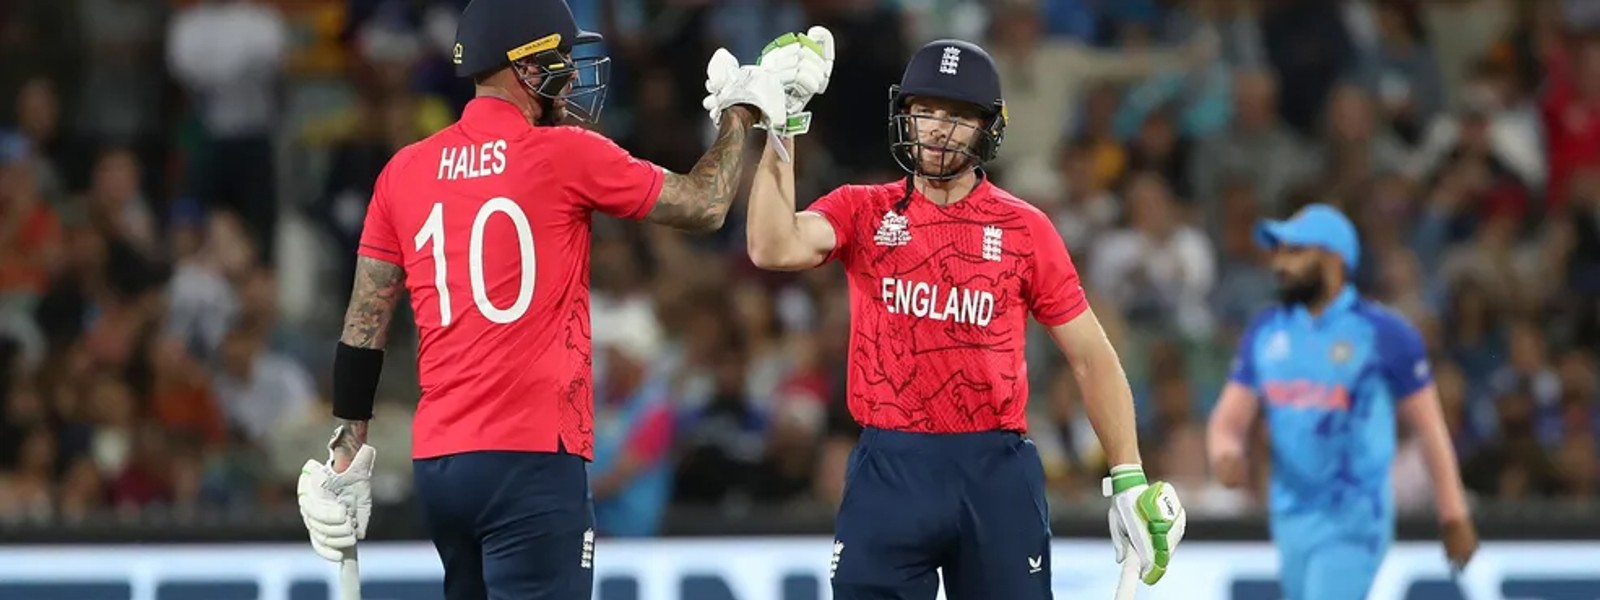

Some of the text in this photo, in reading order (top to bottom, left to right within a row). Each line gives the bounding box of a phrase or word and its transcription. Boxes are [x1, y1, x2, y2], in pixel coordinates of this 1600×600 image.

[437, 139, 507, 180] HALES
[413, 196, 537, 327] 10
[881, 276, 994, 327] ENGLAND
